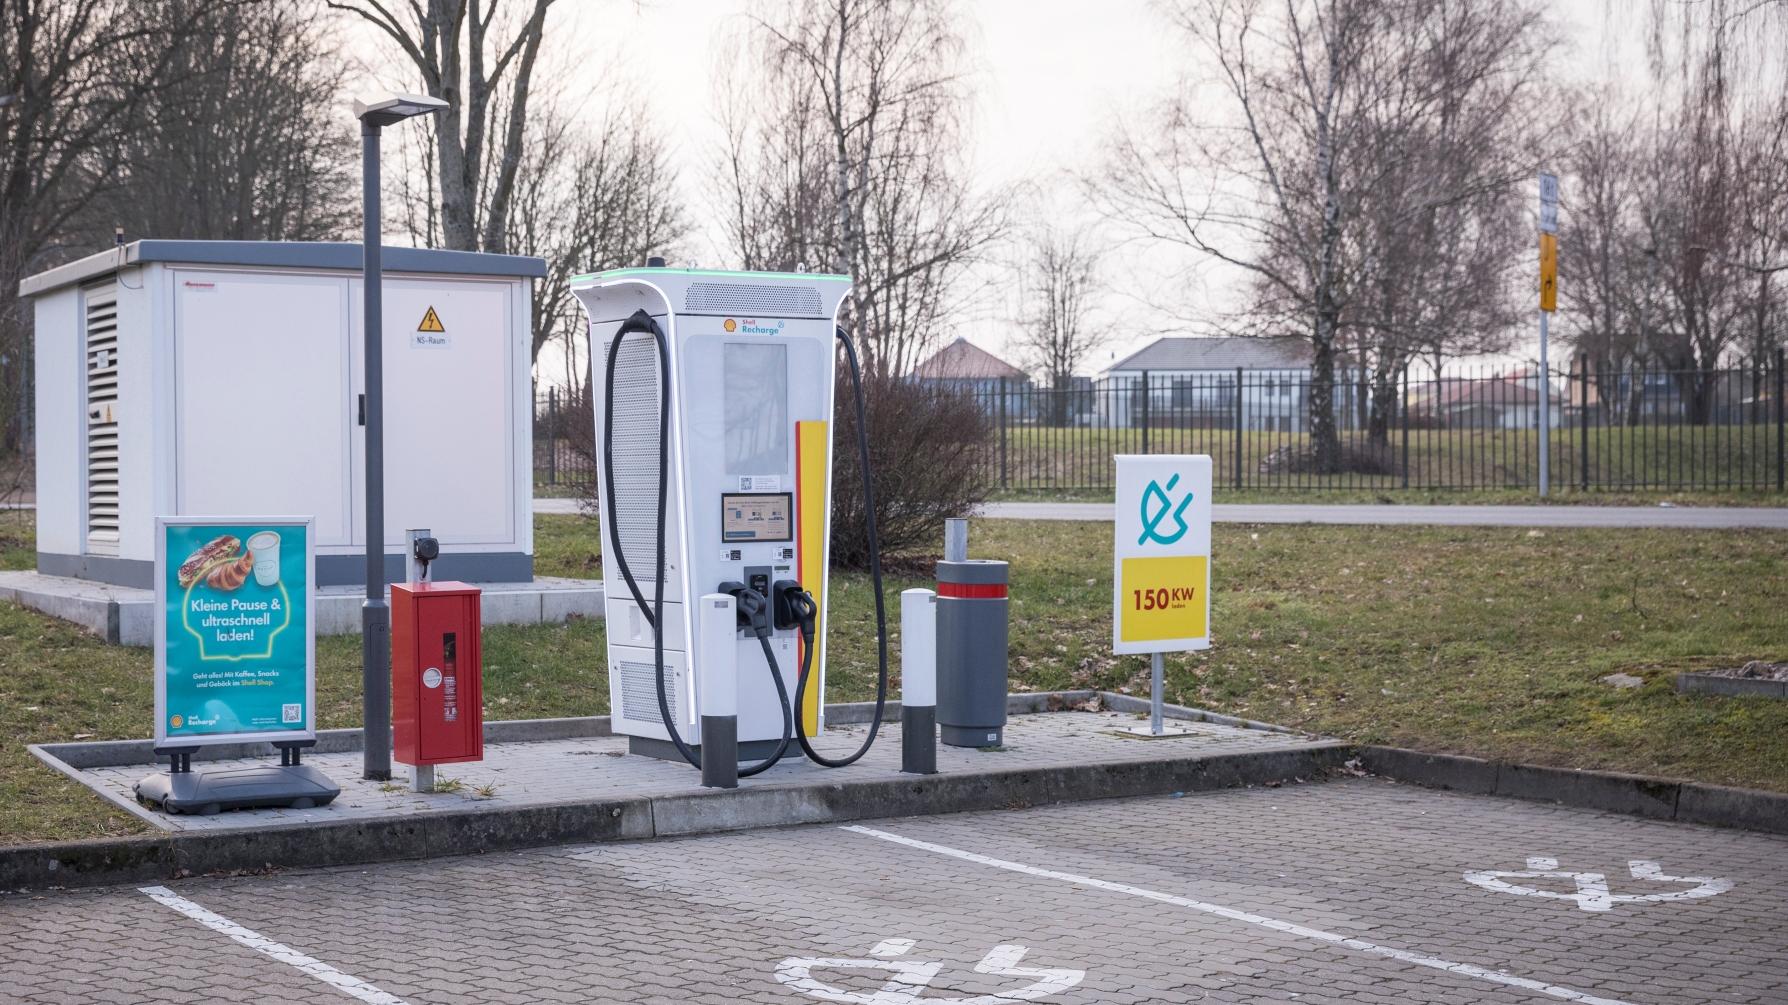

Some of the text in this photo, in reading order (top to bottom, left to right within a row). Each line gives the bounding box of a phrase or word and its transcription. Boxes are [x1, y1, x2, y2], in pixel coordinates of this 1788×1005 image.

[742, 325, 779, 336] Recharge
[417, 336, 446, 345] NS-Raum
[191, 598, 281, 612] Kleine Pause &
[1134, 587, 1195, 611] 150 KW
[202, 612, 270, 627] ultraschnell
[216, 628, 254, 642] laden!
[192, 672, 207, 680] Geht
[208, 671, 224, 679] alles!
[234, 670, 257, 678] Kaffee,
[257, 669, 280, 677] Snacks
[209, 680, 232, 688] Gebäck
